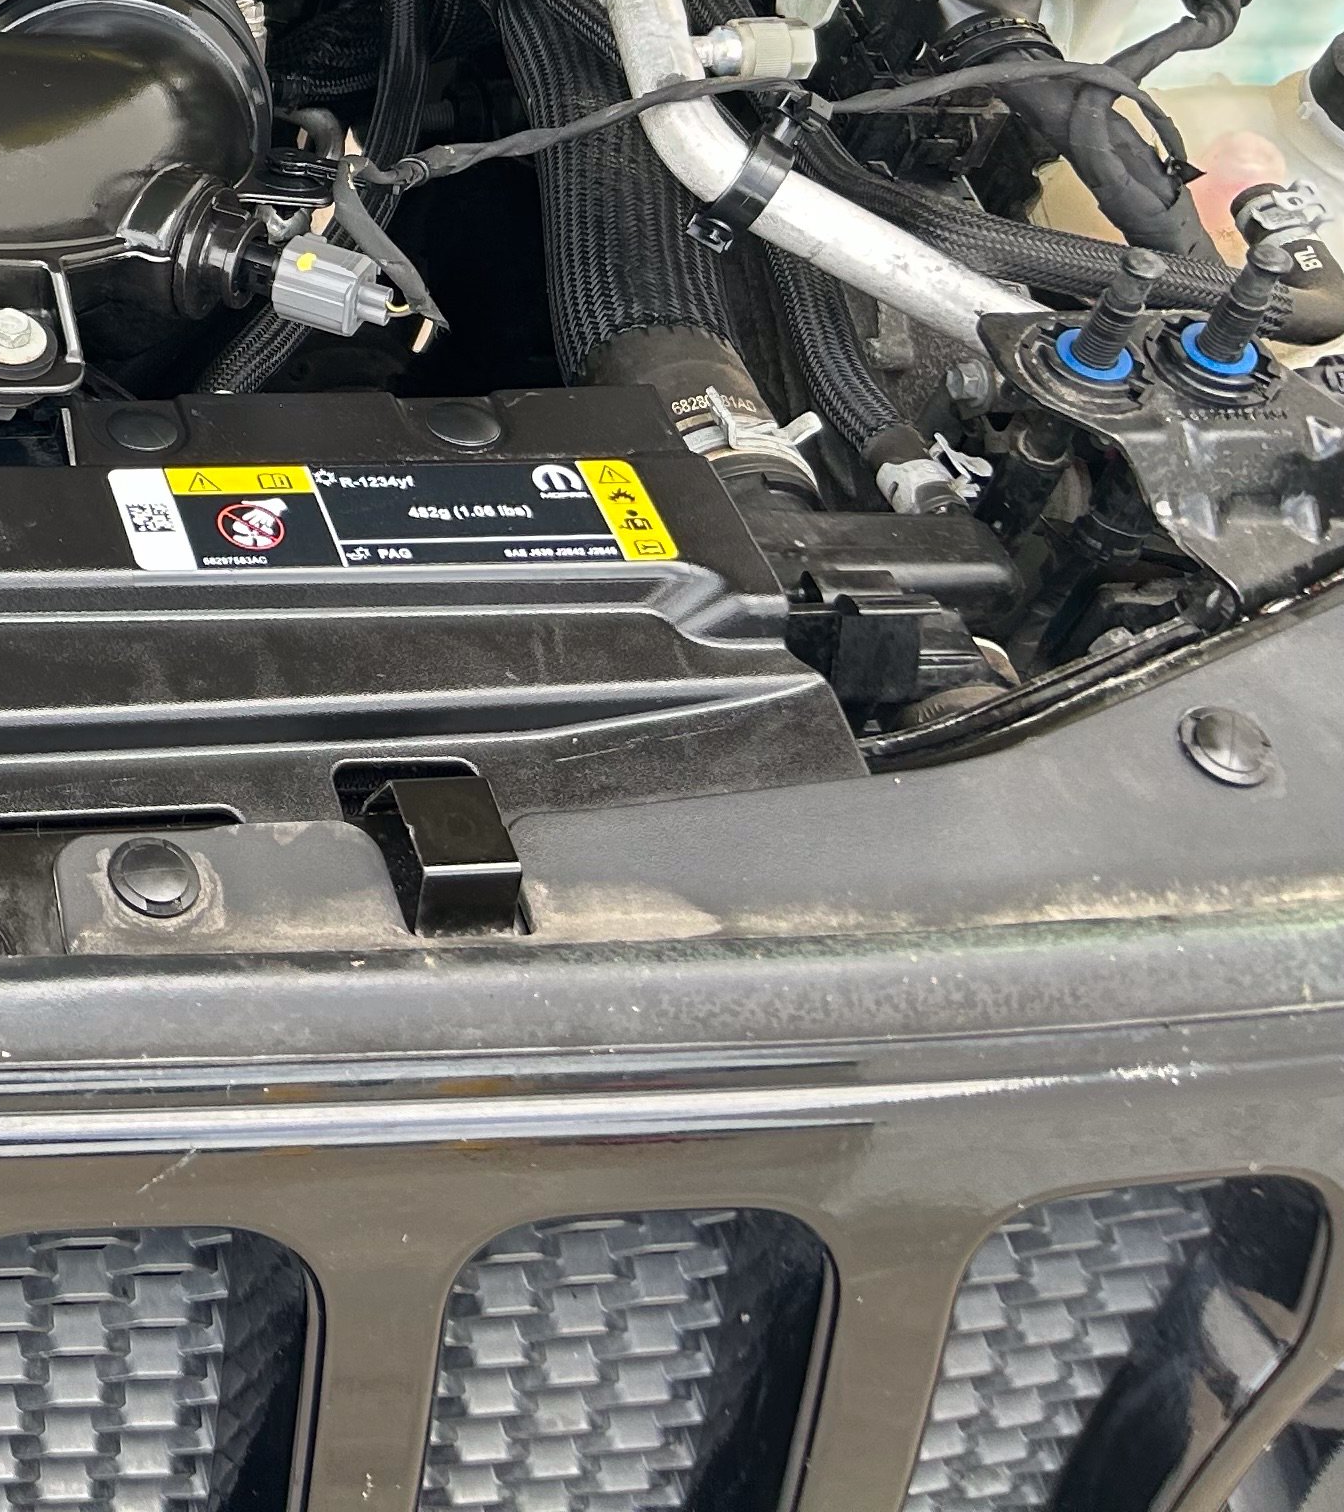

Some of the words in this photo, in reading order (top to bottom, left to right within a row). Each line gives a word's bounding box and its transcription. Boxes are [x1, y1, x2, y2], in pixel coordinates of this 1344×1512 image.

[339, 475, 415, 490] R-1234yf
[497, 503, 535, 519] lbs)
[377, 548, 413, 559] PAG
